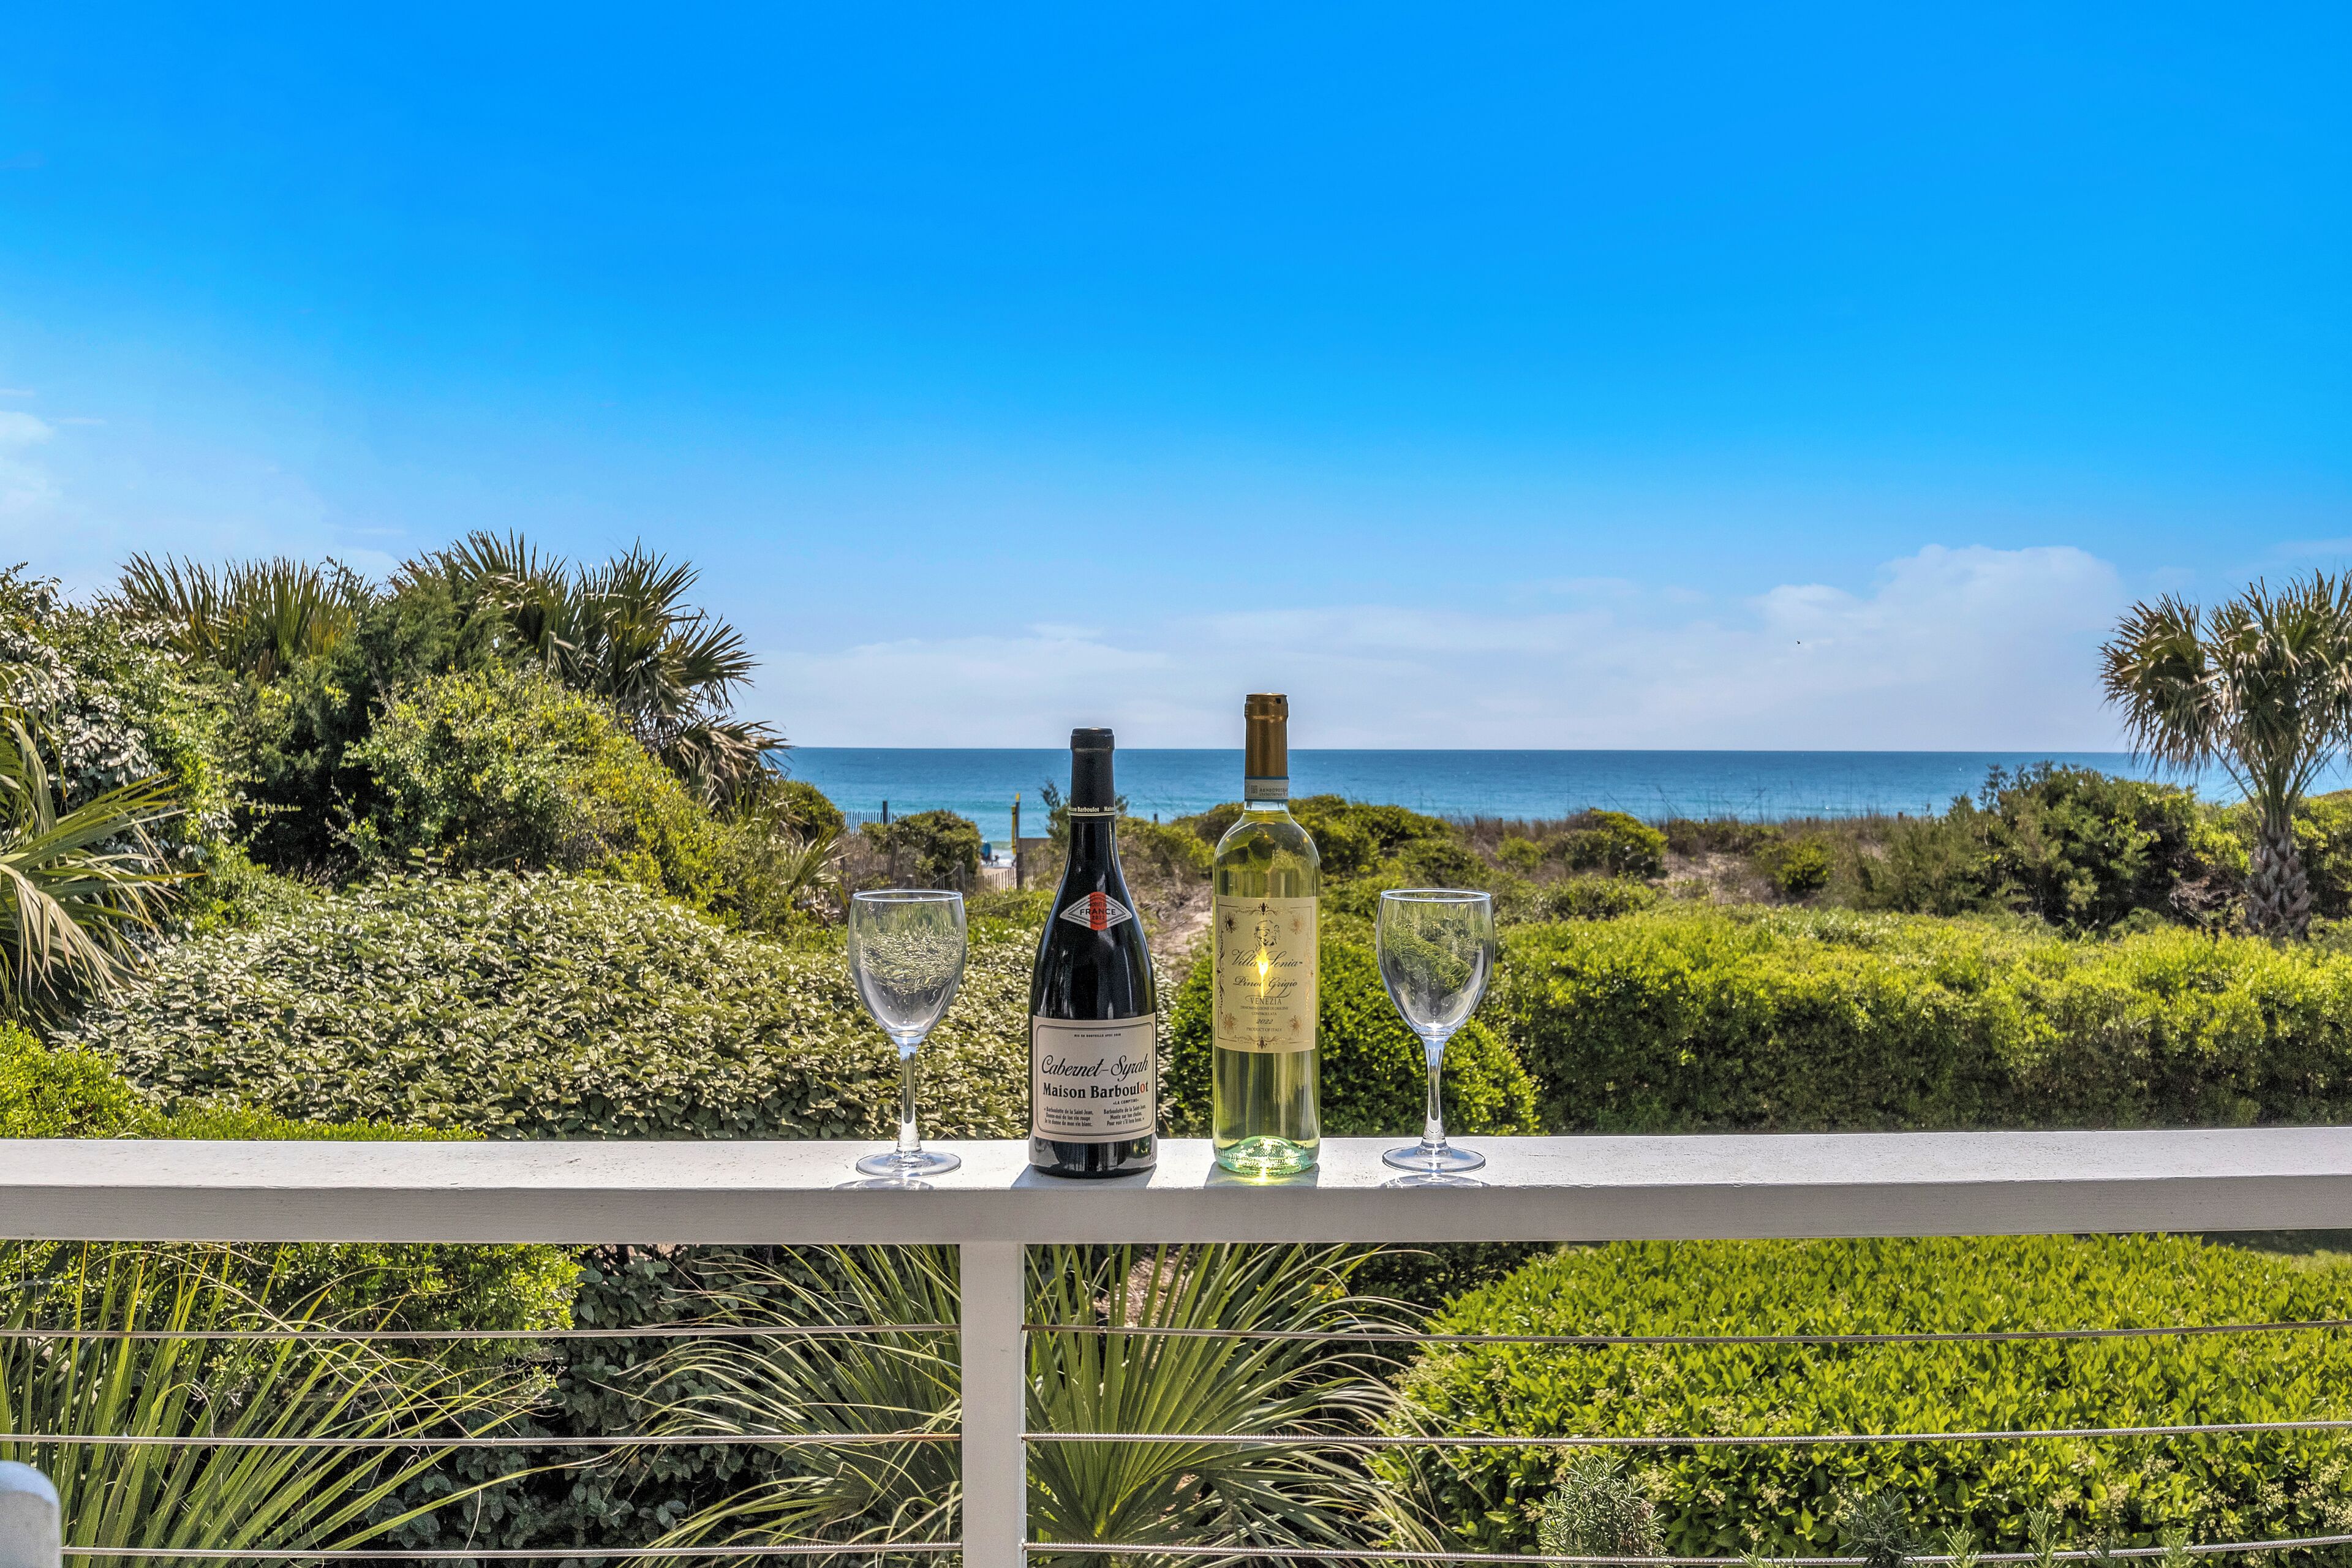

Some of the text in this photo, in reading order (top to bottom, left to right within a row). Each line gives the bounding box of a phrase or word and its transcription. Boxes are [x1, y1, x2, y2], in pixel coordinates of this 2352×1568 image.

[1231, 949, 1257, 967] Villa
[1264, 977, 1298, 998] Grigio
[1043, 1081, 1148, 1098] Maison Barboulot
